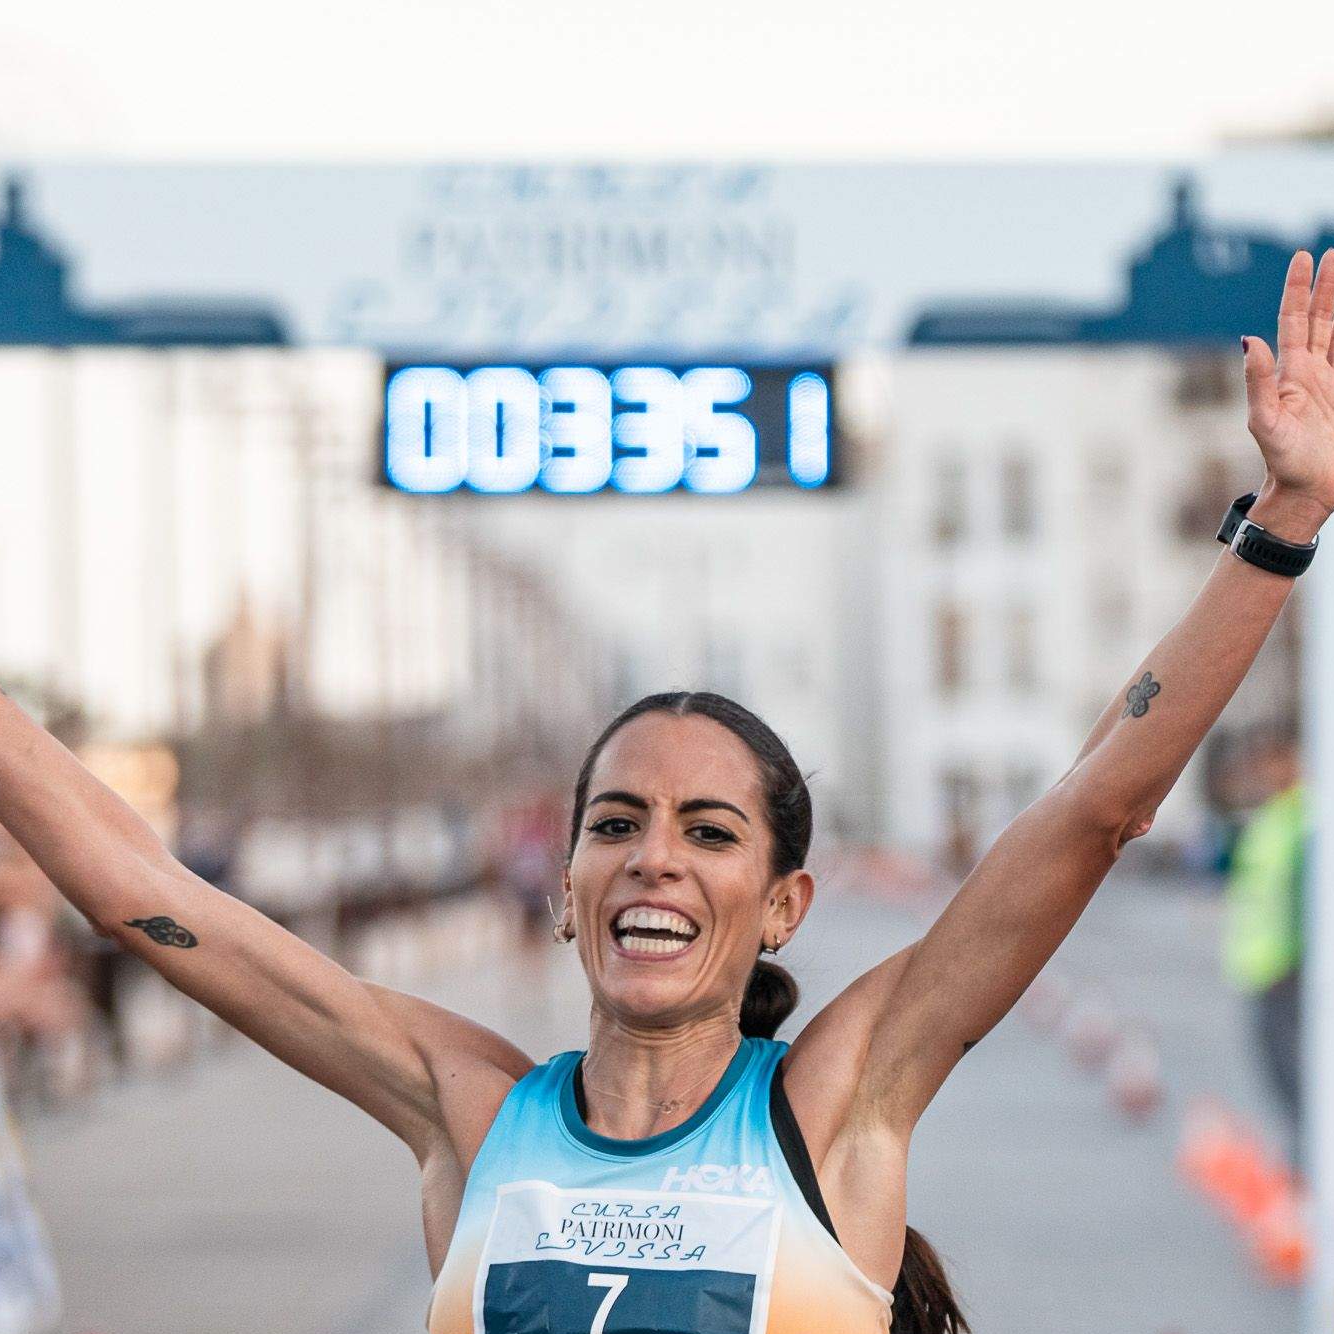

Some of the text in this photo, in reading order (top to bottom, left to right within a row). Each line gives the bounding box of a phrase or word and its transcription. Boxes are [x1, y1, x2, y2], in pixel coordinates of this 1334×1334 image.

[659, 1163, 779, 1197] HOKA
[571, 1202, 681, 1220] CURSA
[560, 1218, 684, 1242] PATRIMONI
[535, 1232, 707, 1262] EIVISSA
